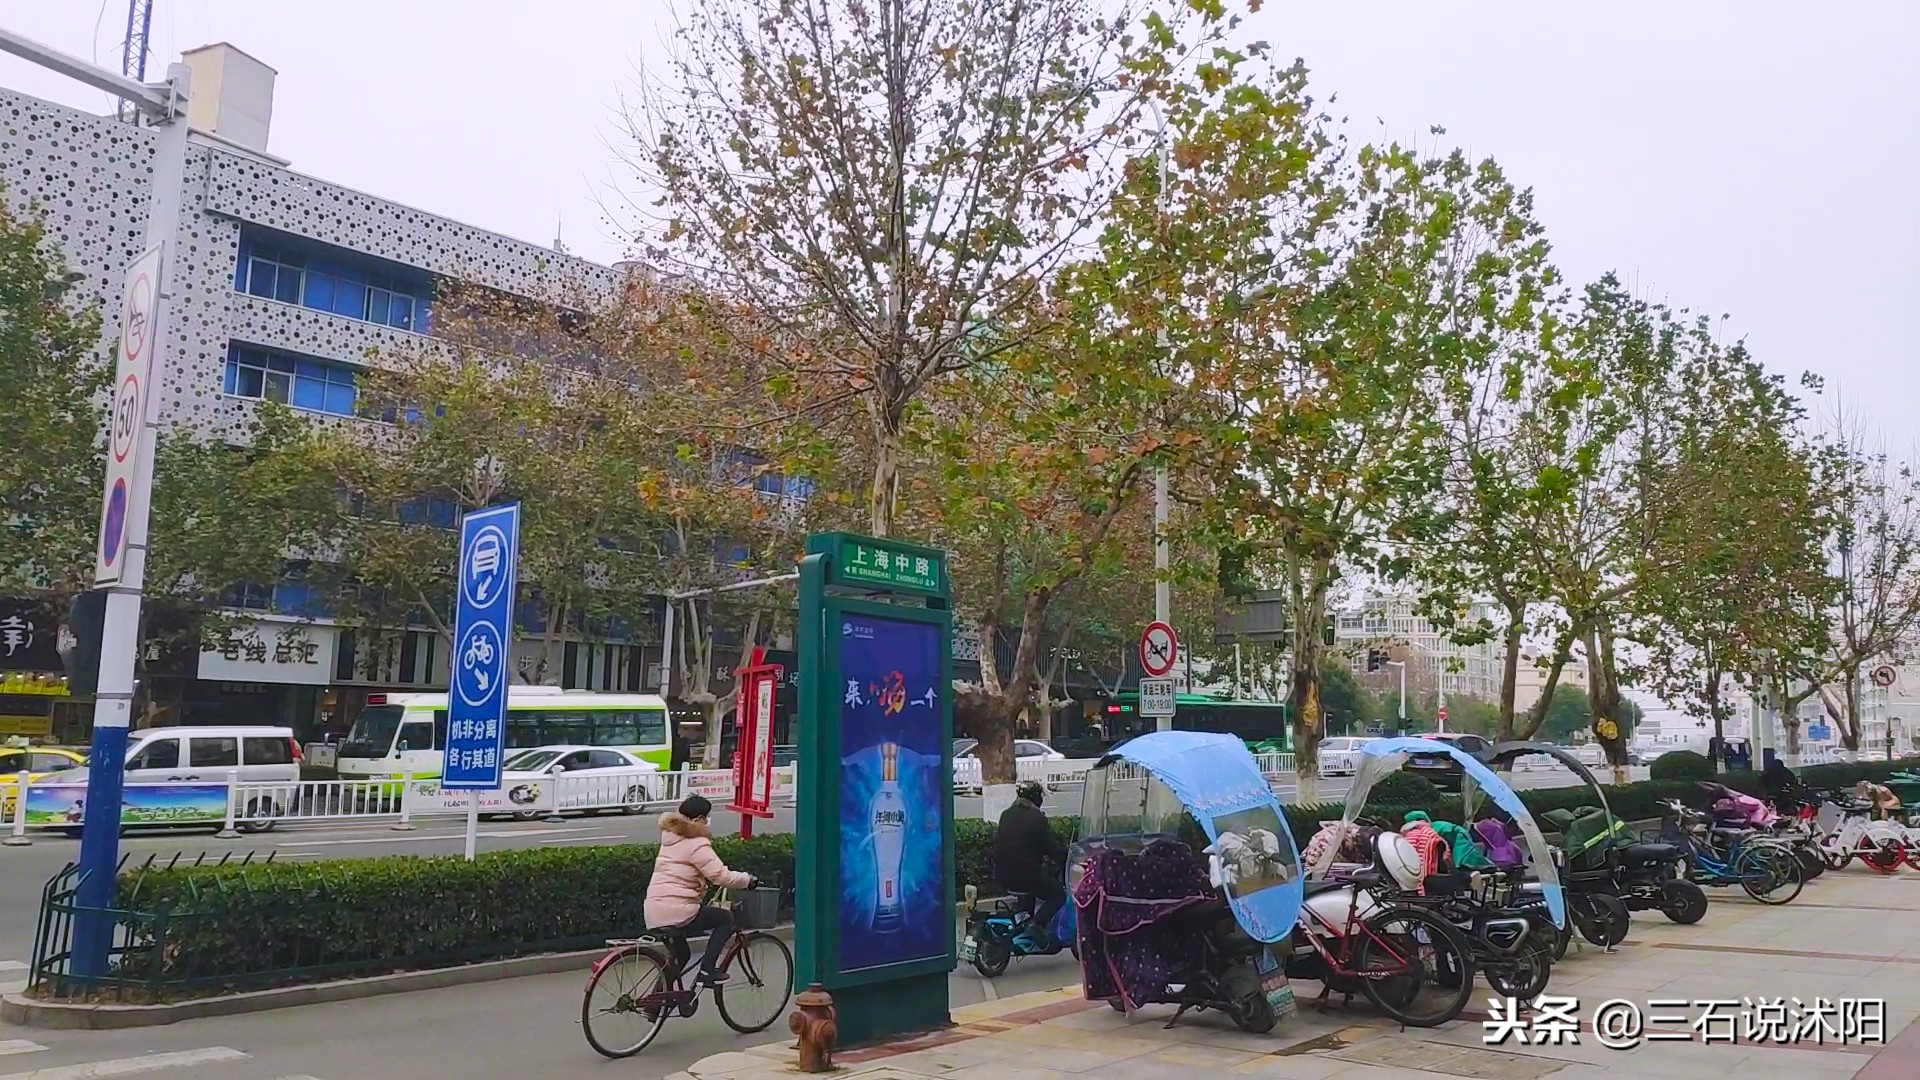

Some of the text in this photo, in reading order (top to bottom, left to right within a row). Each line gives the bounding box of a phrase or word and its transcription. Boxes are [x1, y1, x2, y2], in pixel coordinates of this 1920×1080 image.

[118, 396, 134, 439] 50
[852, 546, 929, 576] 上海中路
[859, 568, 891, 579] SHANGHAI
[895, 574, 923, 584] ZHONGLU
[451, 718, 497, 741] 机非分离
[448, 746, 496, 771] 各行其道
